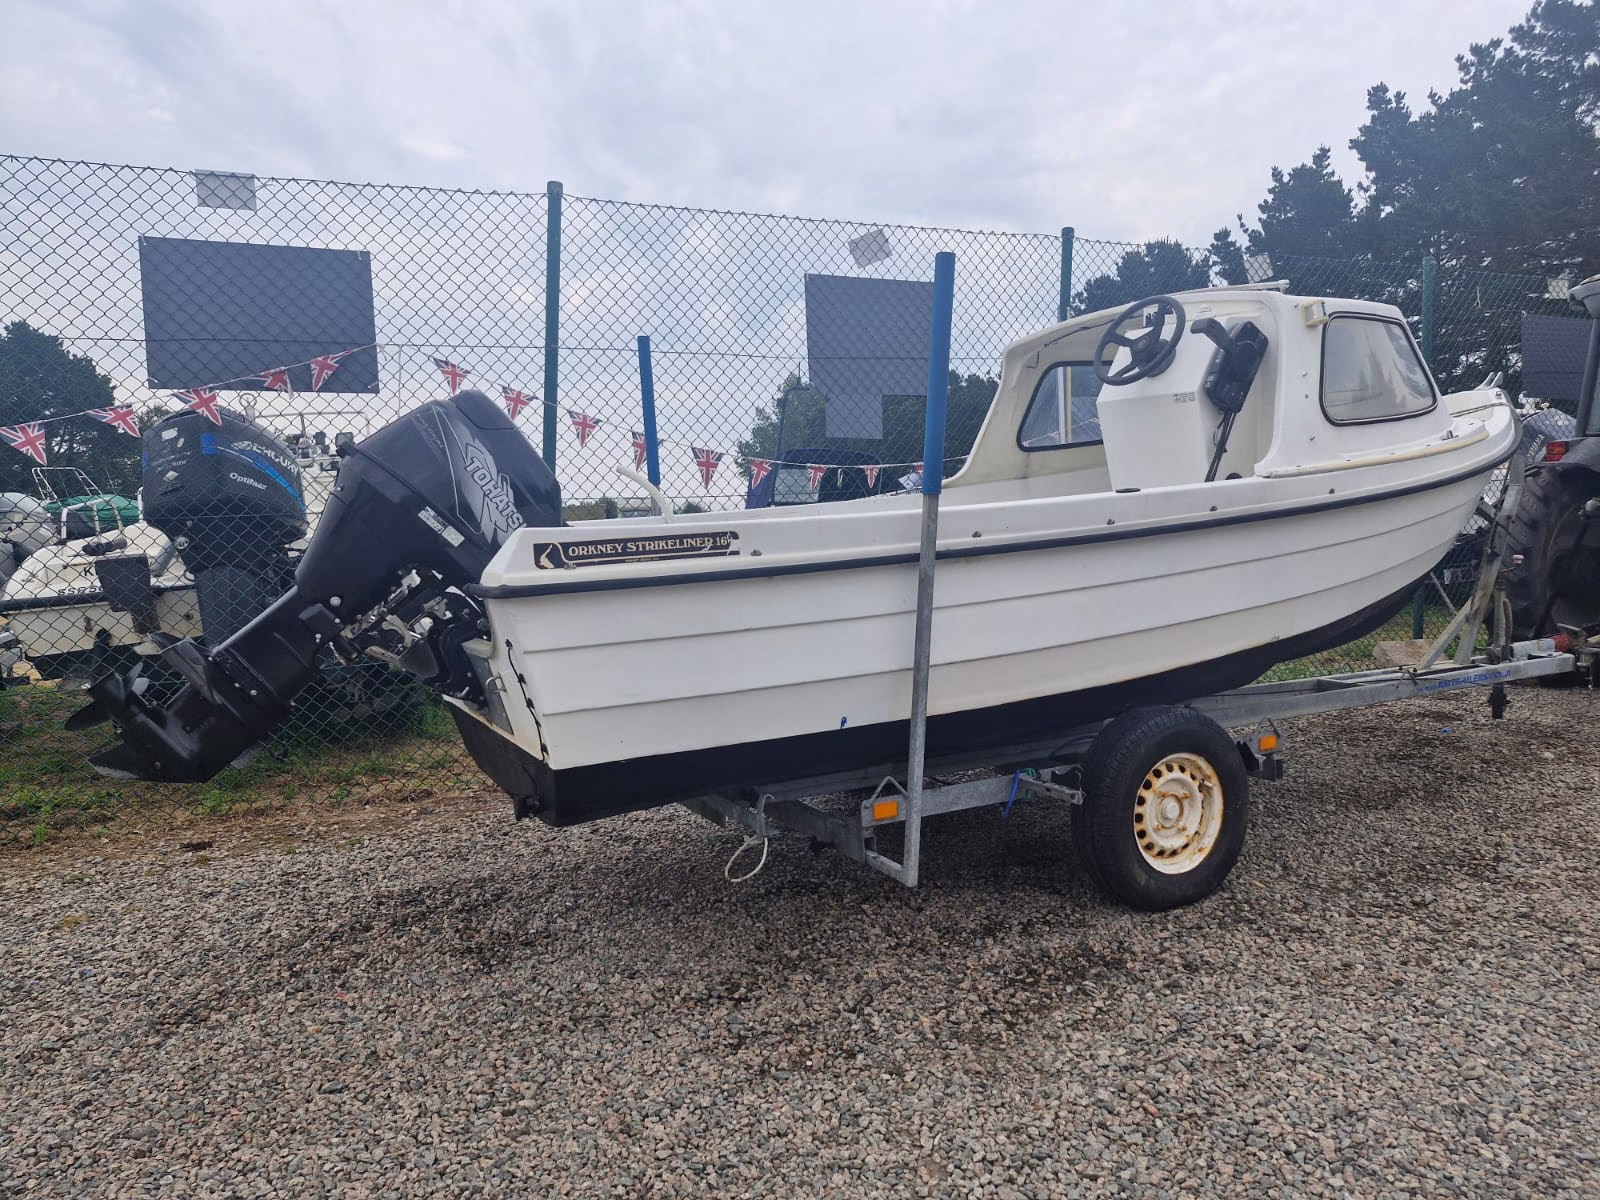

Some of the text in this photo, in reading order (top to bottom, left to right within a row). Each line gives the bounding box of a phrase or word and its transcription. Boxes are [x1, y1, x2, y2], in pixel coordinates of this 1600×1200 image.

[464, 456, 528, 530] TOHATS
[568, 542, 624, 557] ORKNEY
[626, 536, 714, 552] STRIKELINER
